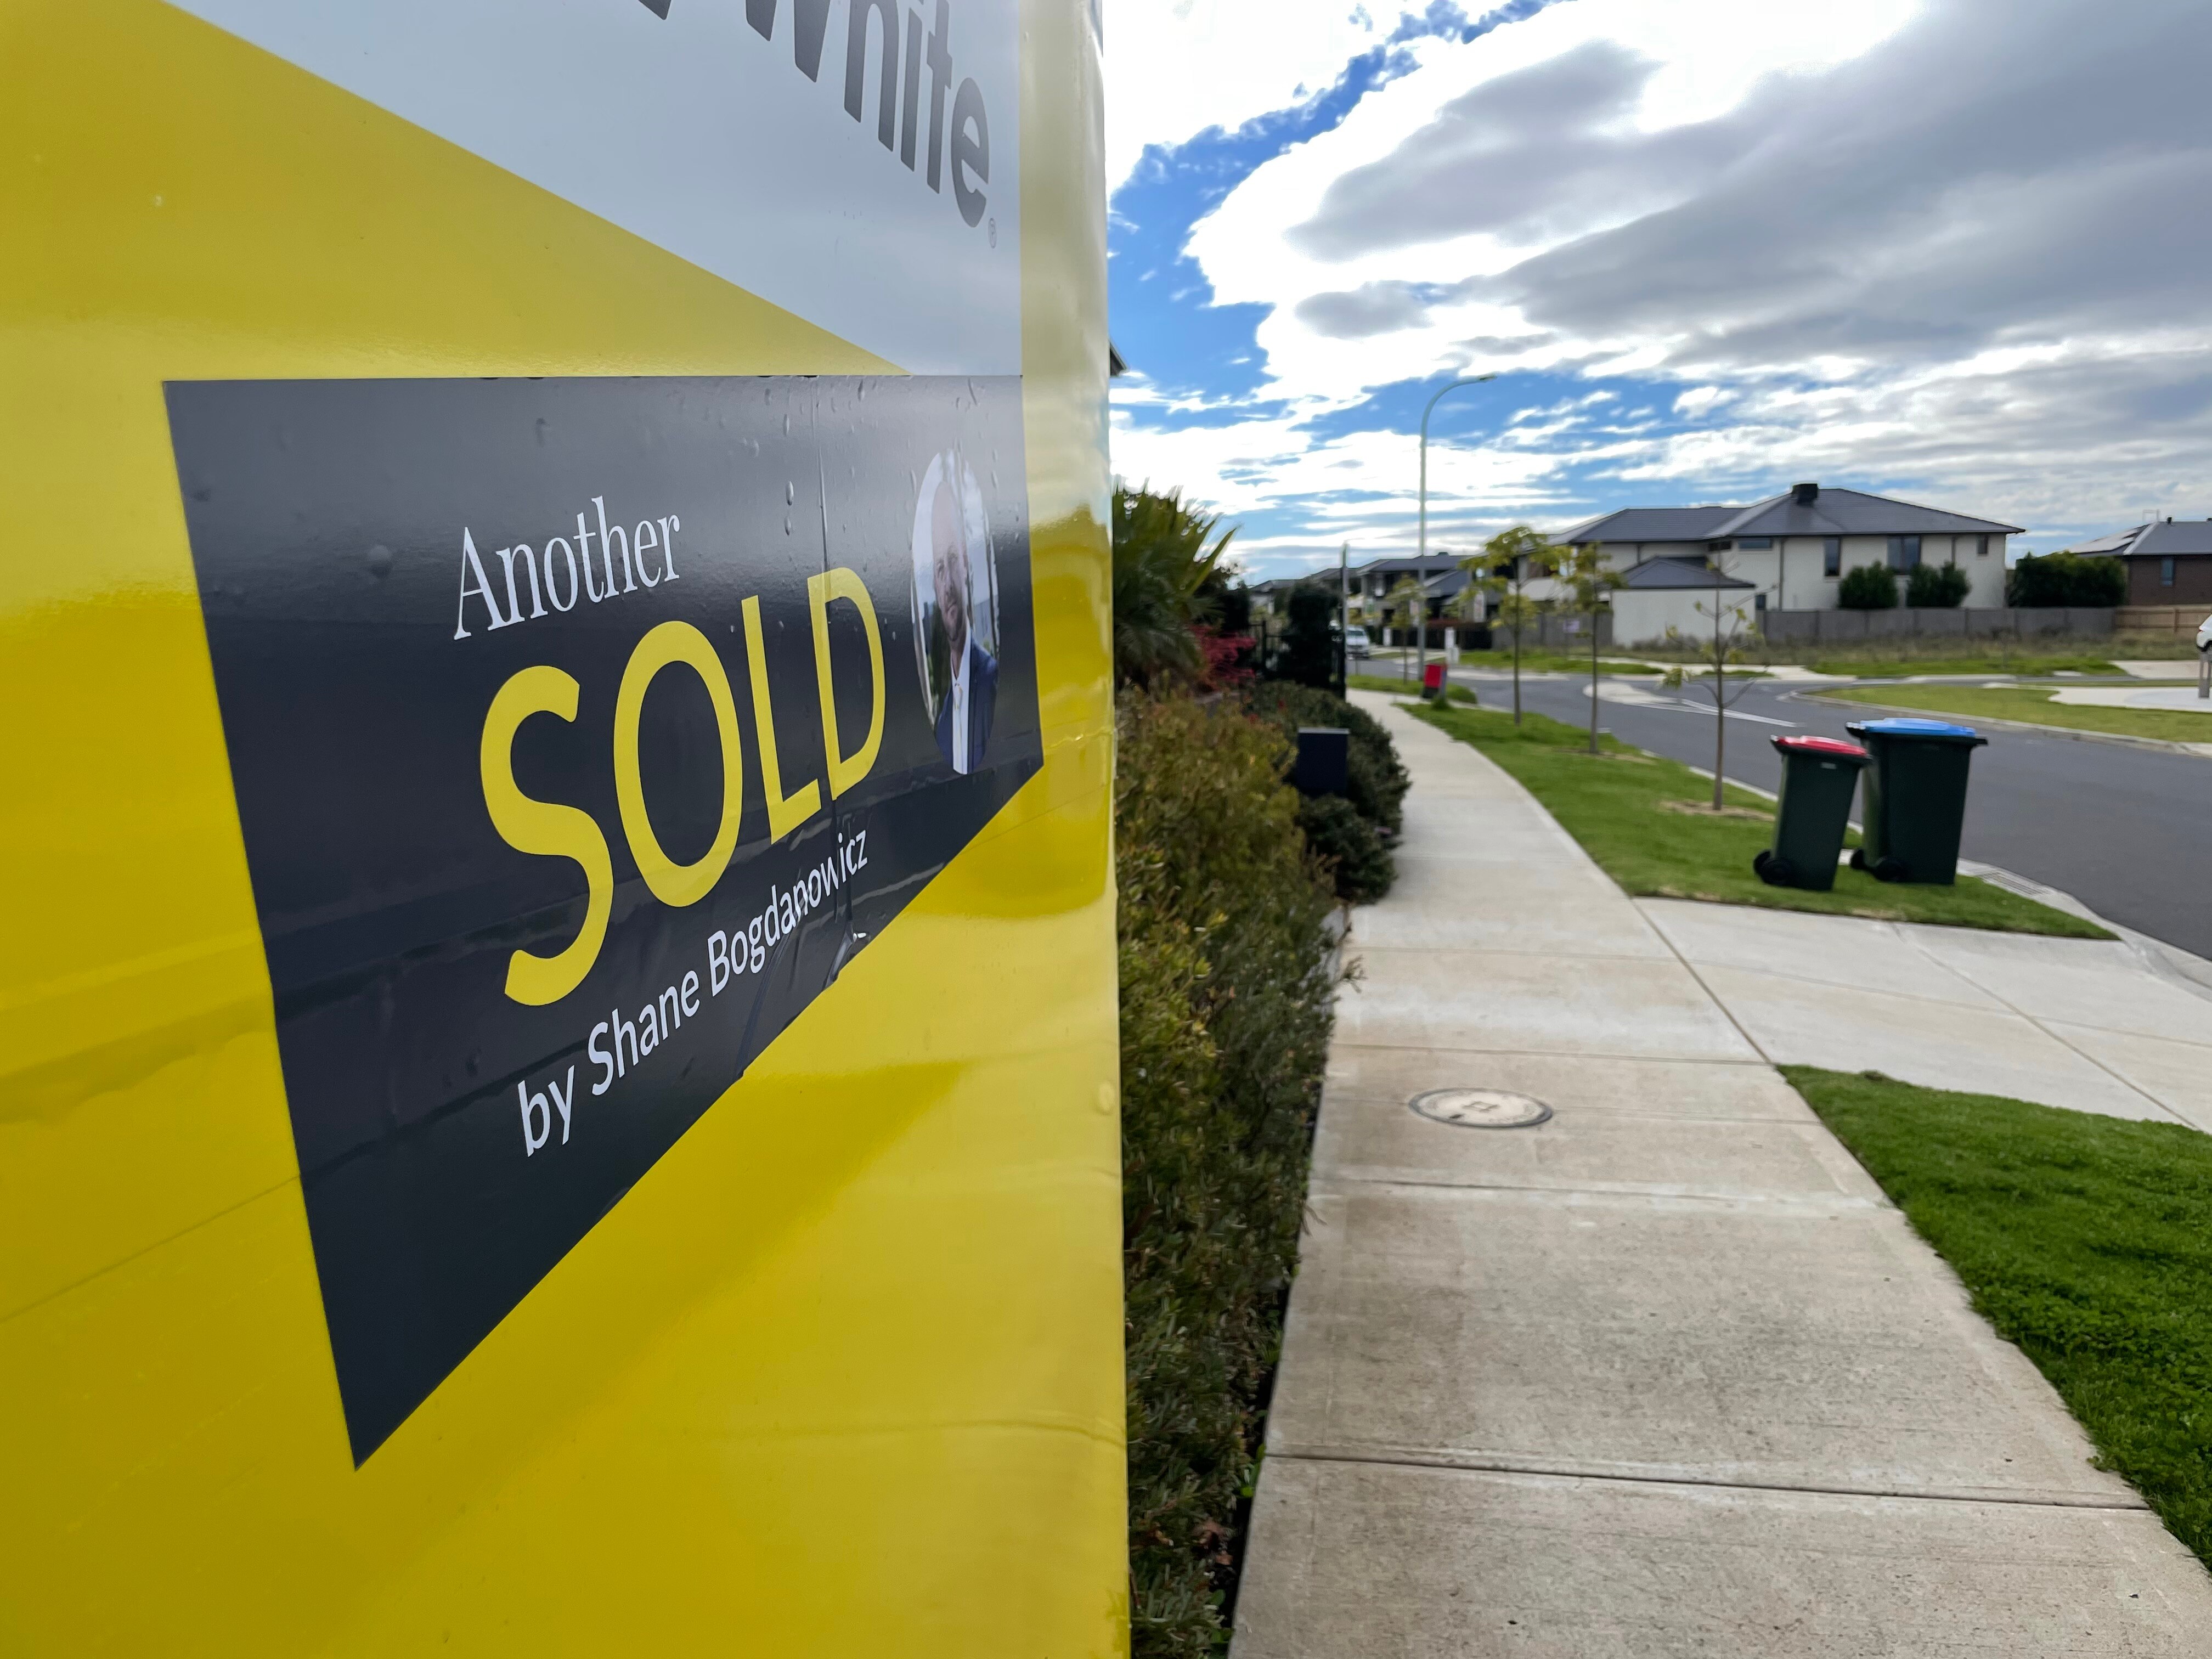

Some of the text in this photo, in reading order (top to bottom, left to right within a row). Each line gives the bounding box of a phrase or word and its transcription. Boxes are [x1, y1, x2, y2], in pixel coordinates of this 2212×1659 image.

[454, 494, 681, 641] Another
[480, 567, 886, 1007] SOLD
[517, 829, 868, 1158] by Shane Bogdanowicz
